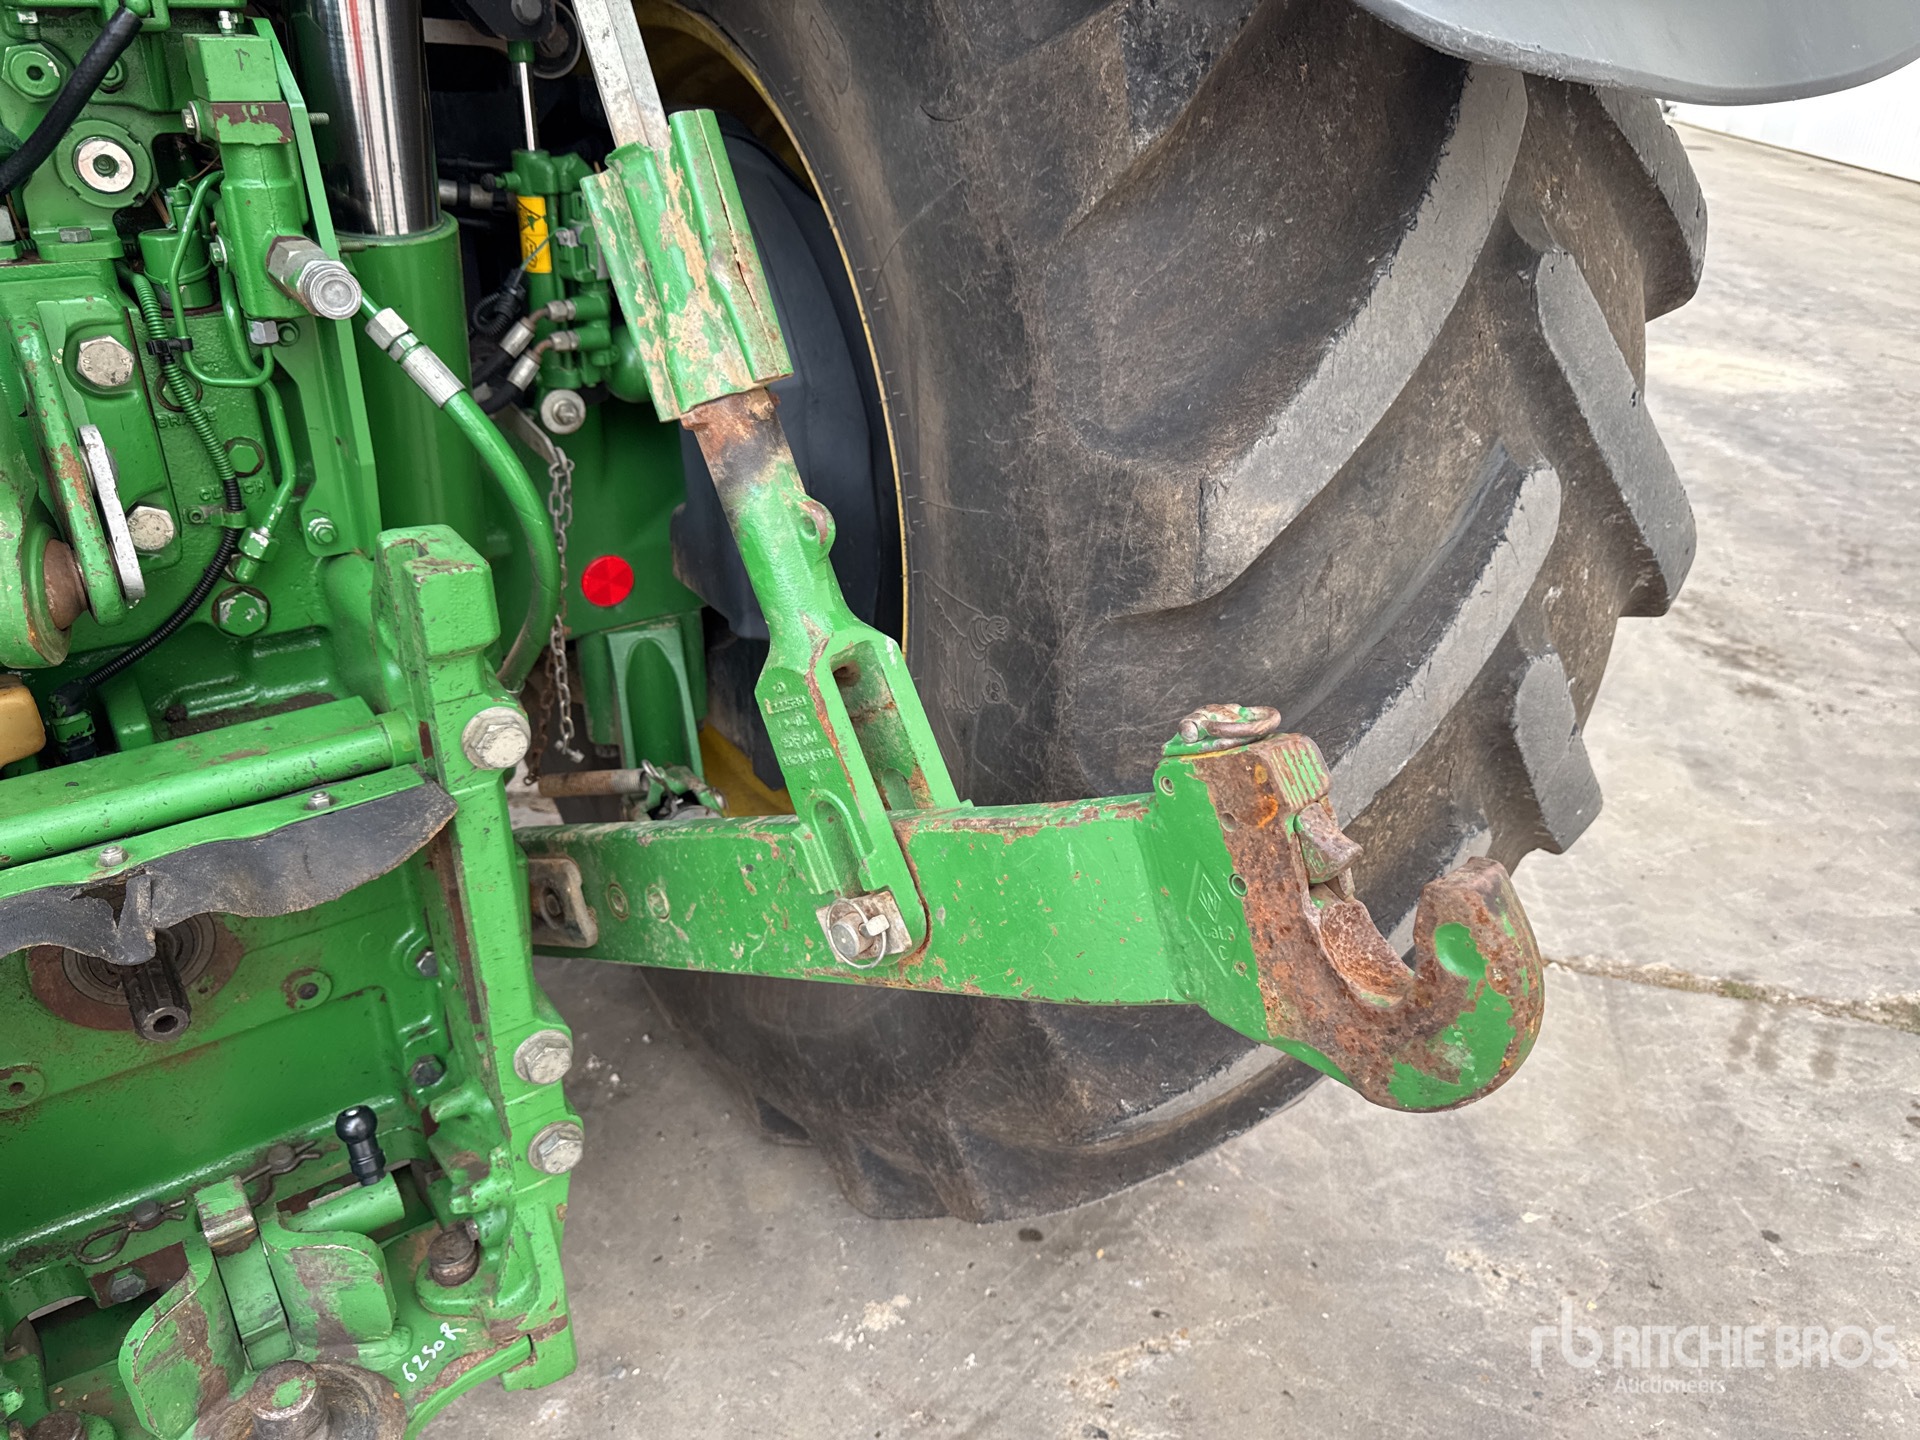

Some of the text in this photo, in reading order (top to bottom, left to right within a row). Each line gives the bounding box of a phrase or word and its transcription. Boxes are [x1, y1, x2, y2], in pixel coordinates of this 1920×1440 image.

[157, 405, 217, 428] BRE
[199, 479, 266, 501] CLCH
[401, 1322, 468, 1383] 6250R
